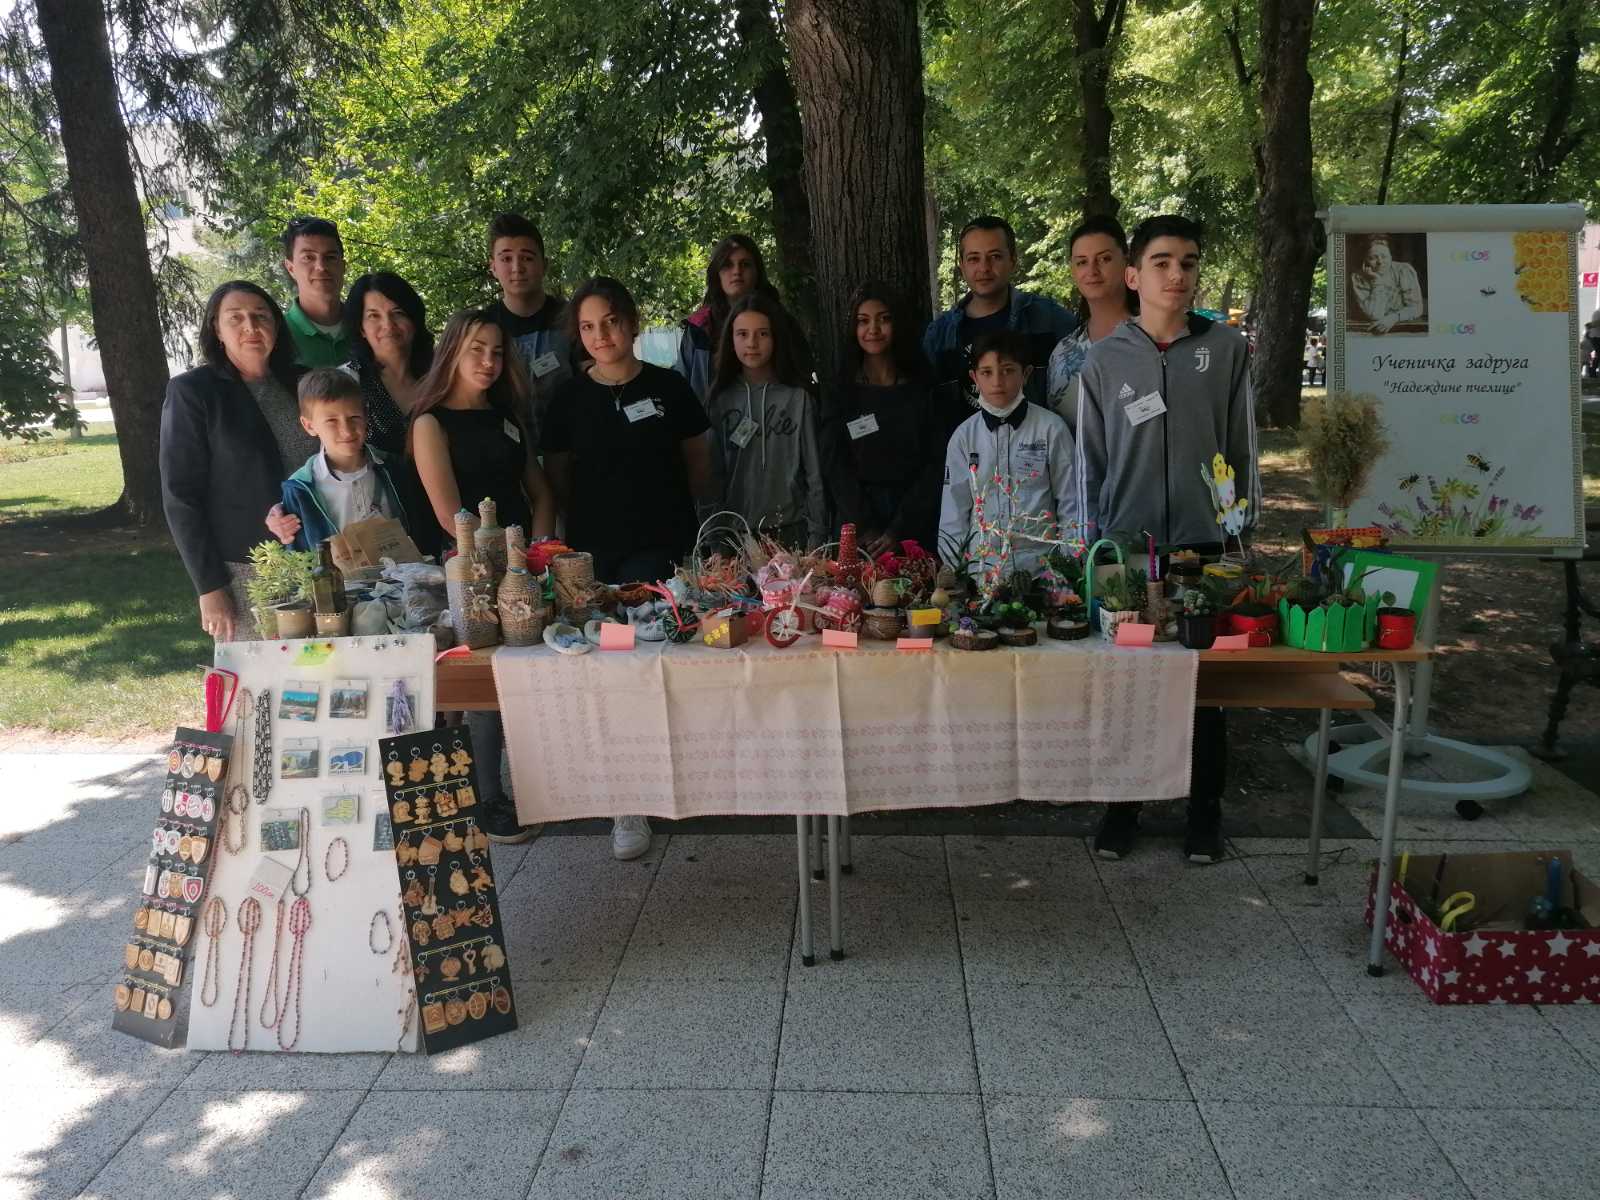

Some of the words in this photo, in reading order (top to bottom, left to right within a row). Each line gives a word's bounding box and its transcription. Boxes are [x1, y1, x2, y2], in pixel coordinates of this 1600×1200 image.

[1372, 354, 1457, 372] Ученичка
[1465, 353, 1529, 374] задруга
[1384, 379, 1464, 395] "Надеждине
